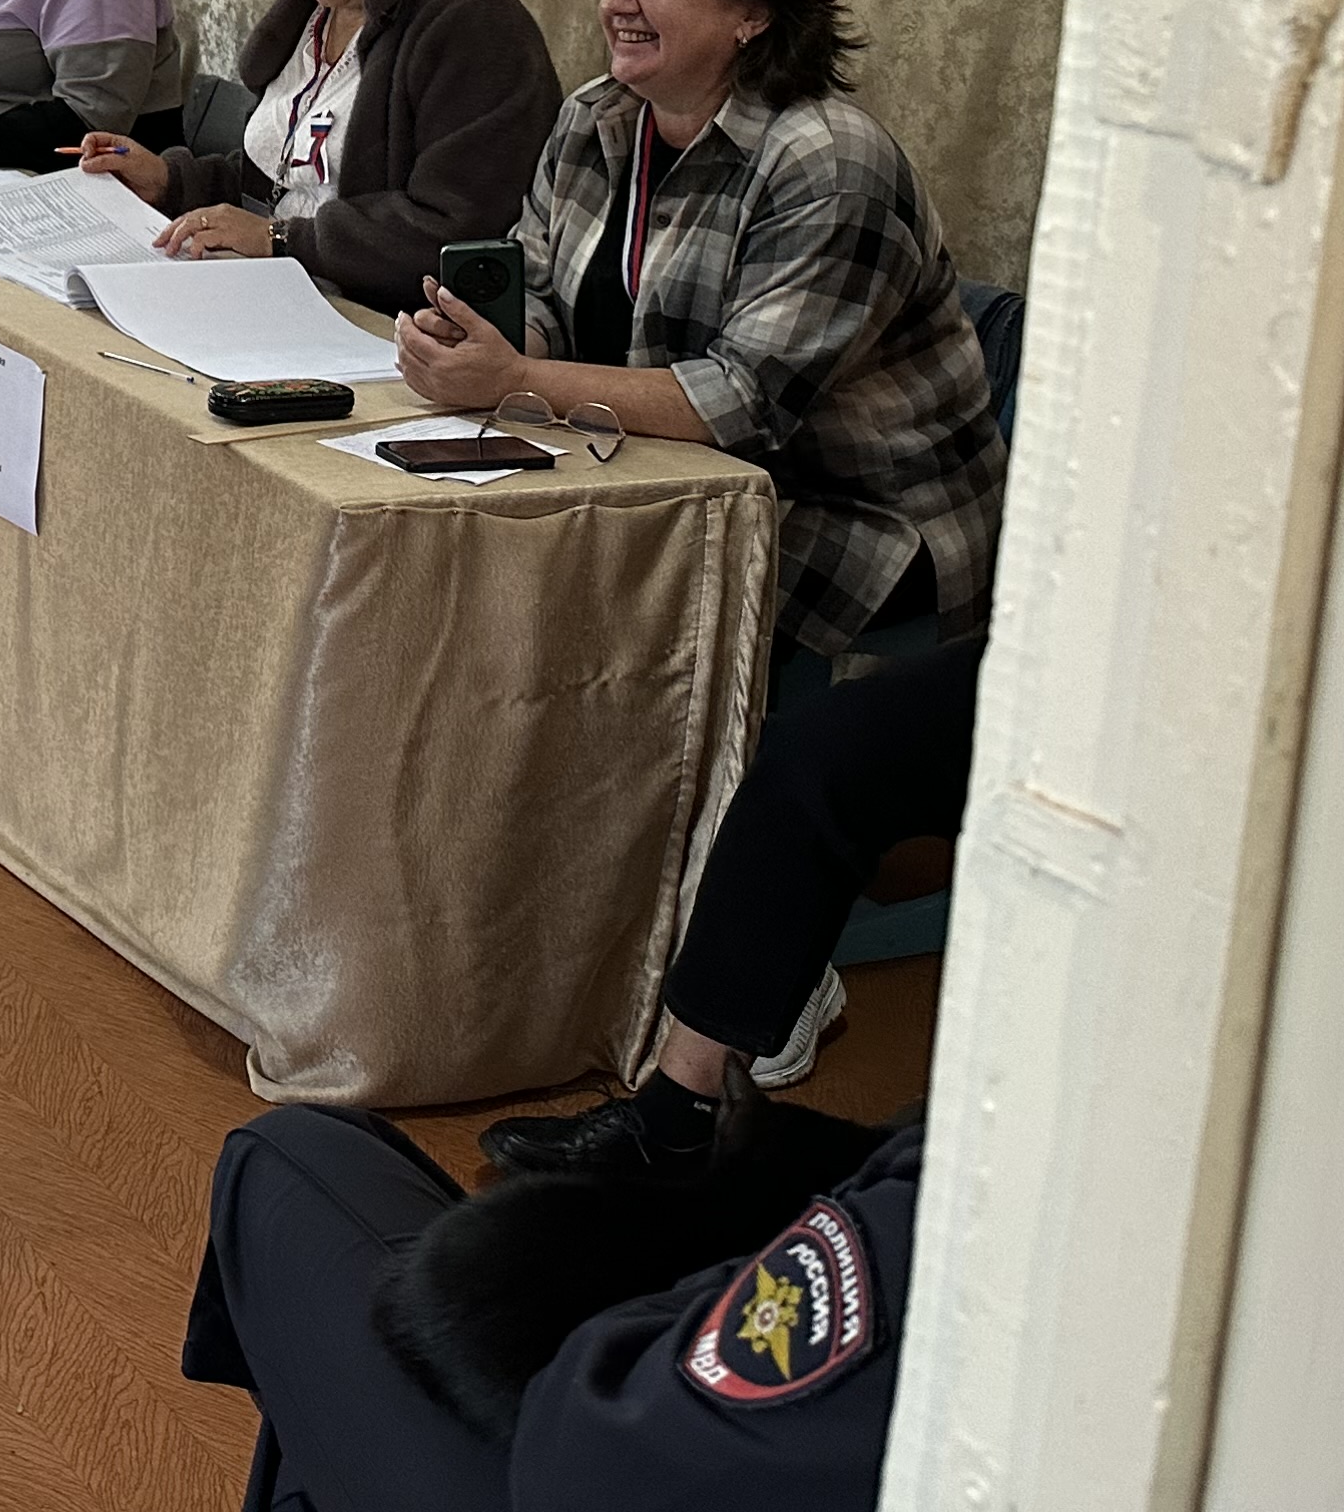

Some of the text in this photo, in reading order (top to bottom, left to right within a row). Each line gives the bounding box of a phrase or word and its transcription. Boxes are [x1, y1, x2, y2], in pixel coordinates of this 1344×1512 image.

[786, 1242, 830, 1345] РОССИЯ
[808, 1211, 861, 1345] ПОЛИЦИЯ
[689, 1329, 730, 1386] МВД
